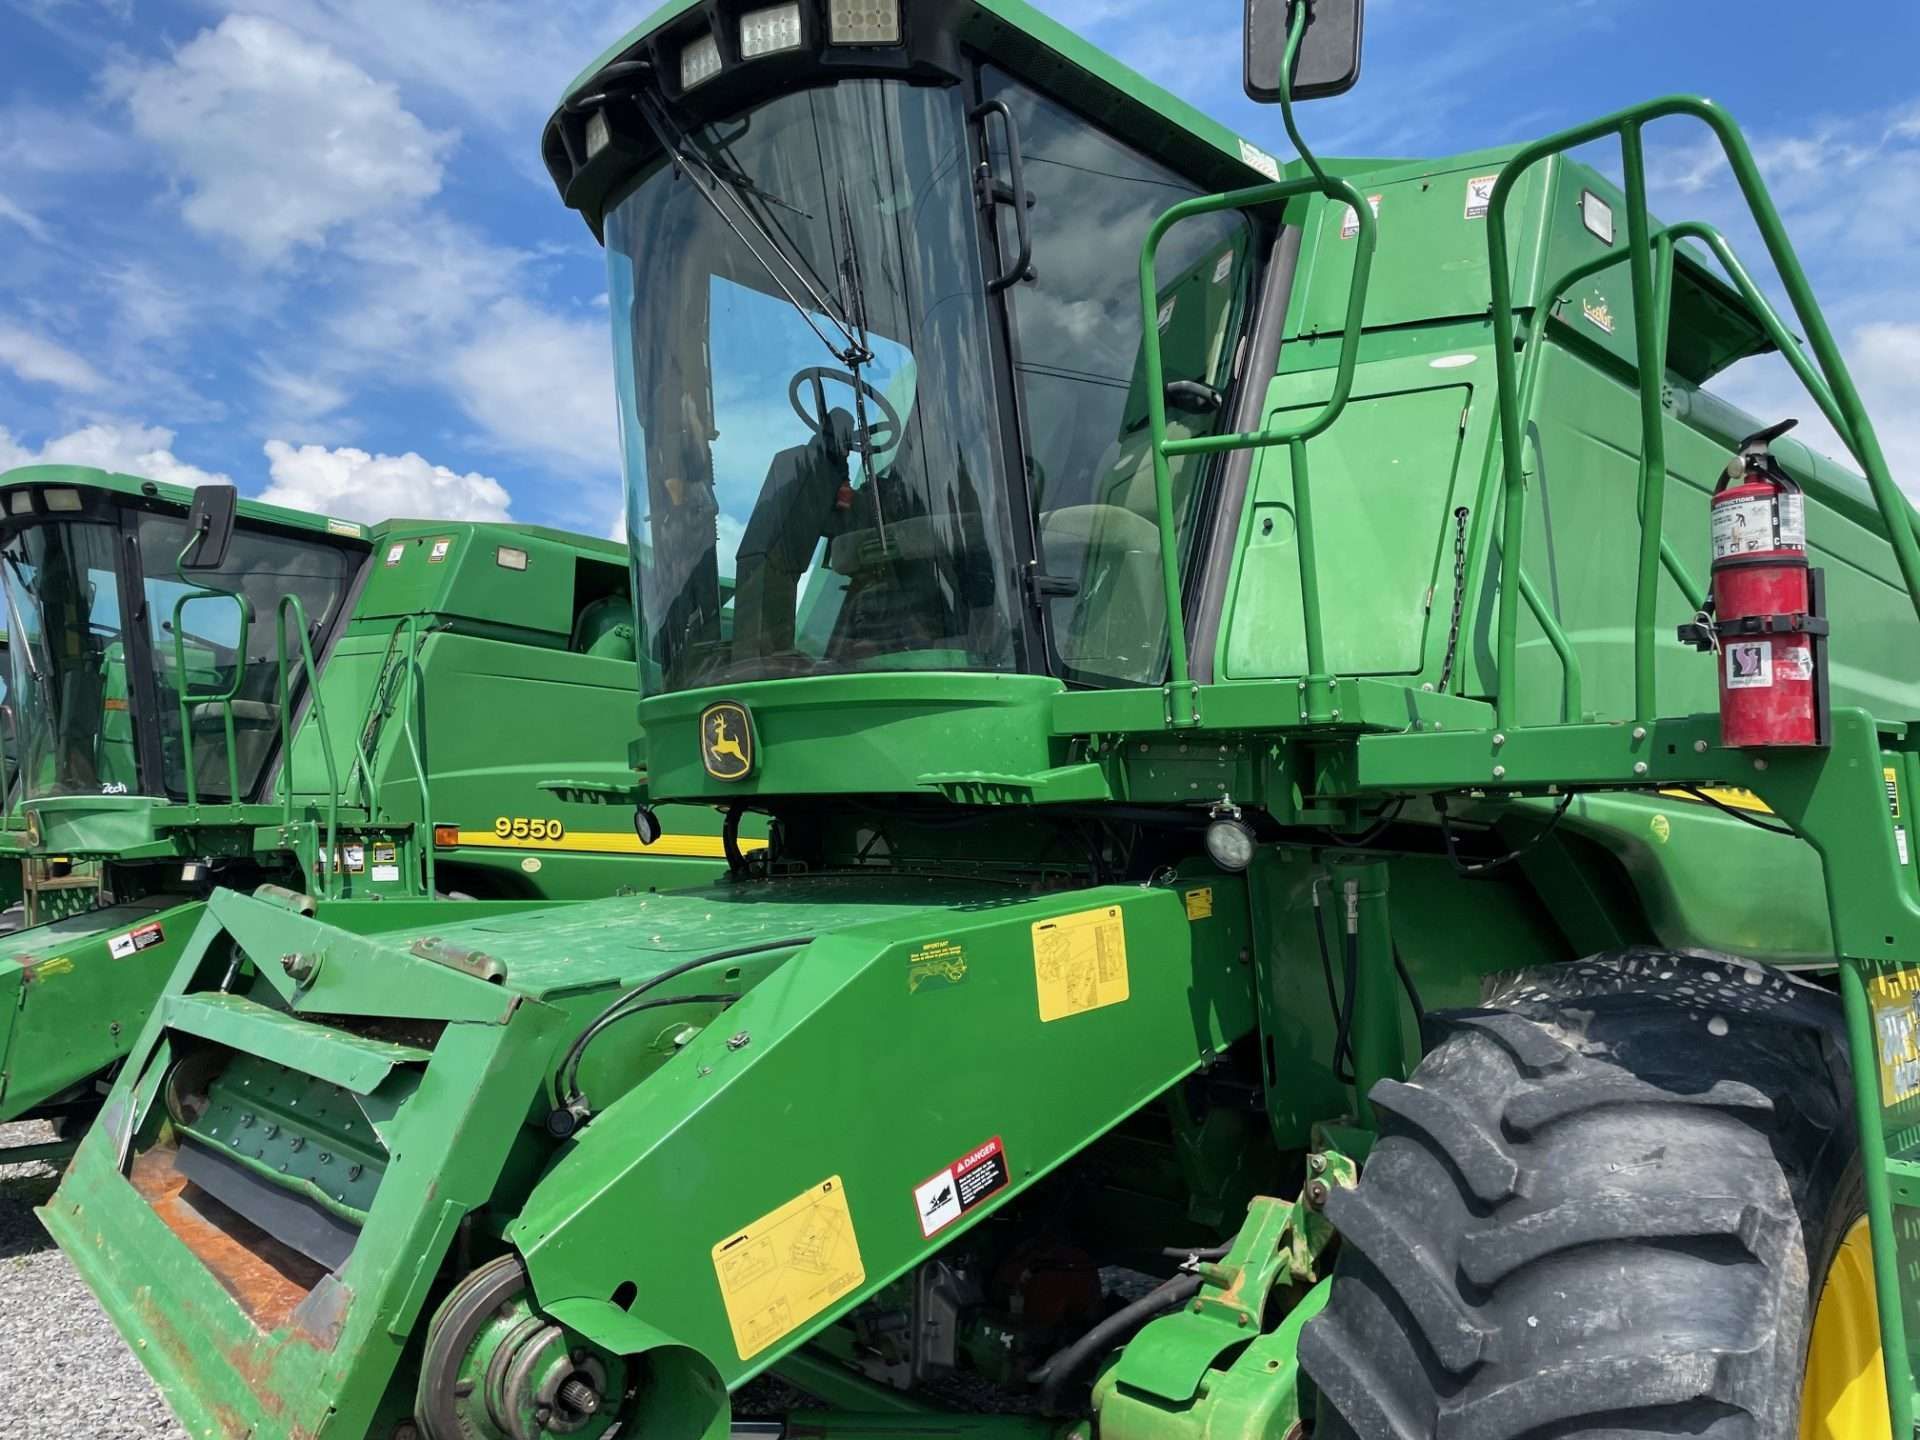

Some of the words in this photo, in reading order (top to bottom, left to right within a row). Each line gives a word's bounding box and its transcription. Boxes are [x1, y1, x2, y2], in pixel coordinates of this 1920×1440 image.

[1771, 496, 1778, 505] A
[1772, 516, 1779, 526] B
[1774, 537, 1781, 546] C
[495, 816, 564, 840] 9550
[964, 1142, 996, 1168] DANGER
